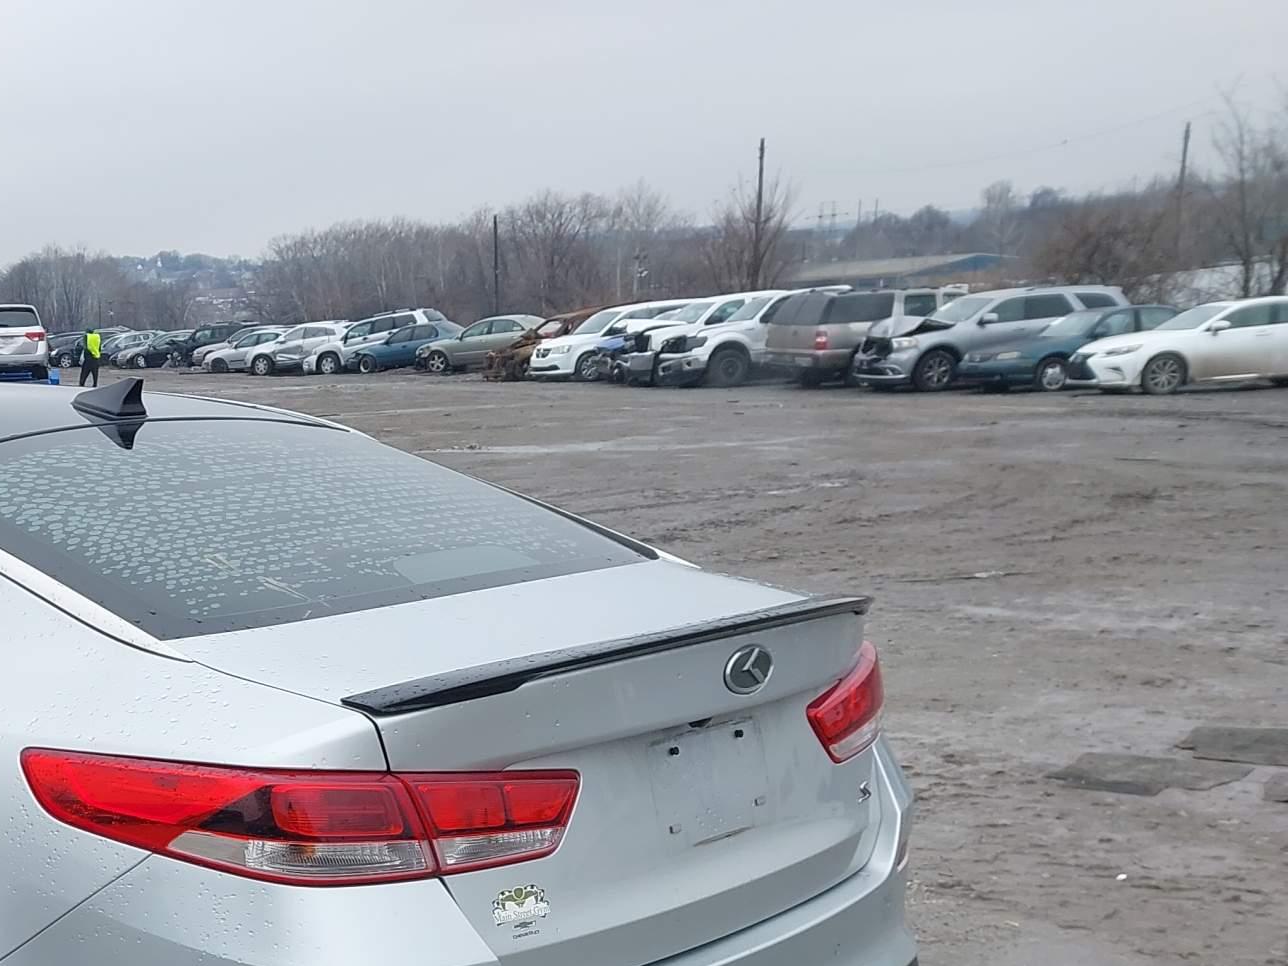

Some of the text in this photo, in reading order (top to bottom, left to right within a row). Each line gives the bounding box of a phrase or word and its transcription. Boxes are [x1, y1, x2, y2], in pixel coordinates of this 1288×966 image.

[494, 905, 551, 923] Main Street Gym
